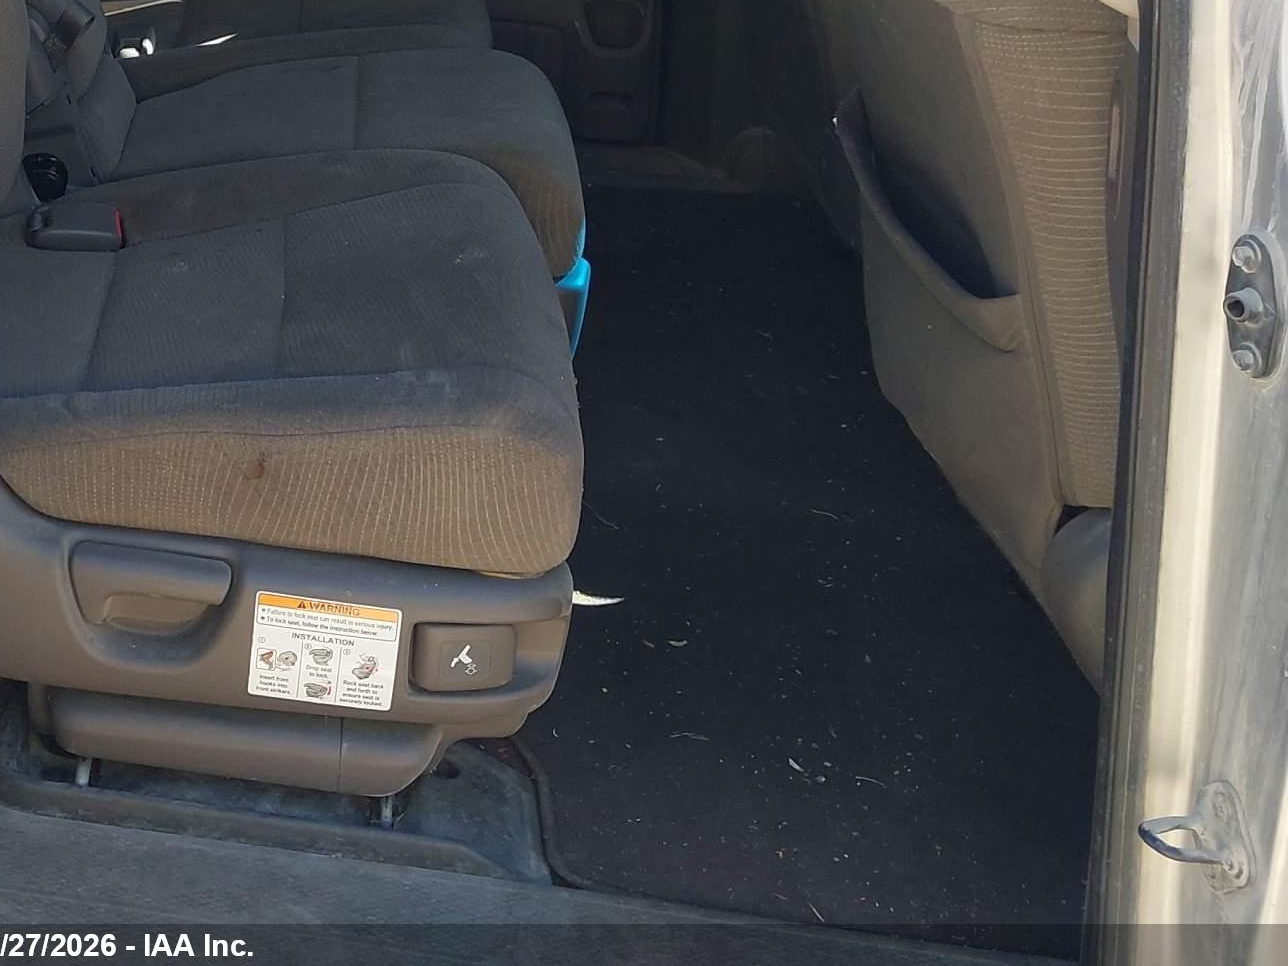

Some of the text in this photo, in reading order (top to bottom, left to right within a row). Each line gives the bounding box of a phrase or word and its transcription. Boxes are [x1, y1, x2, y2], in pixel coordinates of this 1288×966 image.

[267, 608, 286, 616] Failure
[309, 601, 360, 616] WARNING
[302, 620, 318, 628] follow
[292, 632, 354, 646] INSTALLATION
